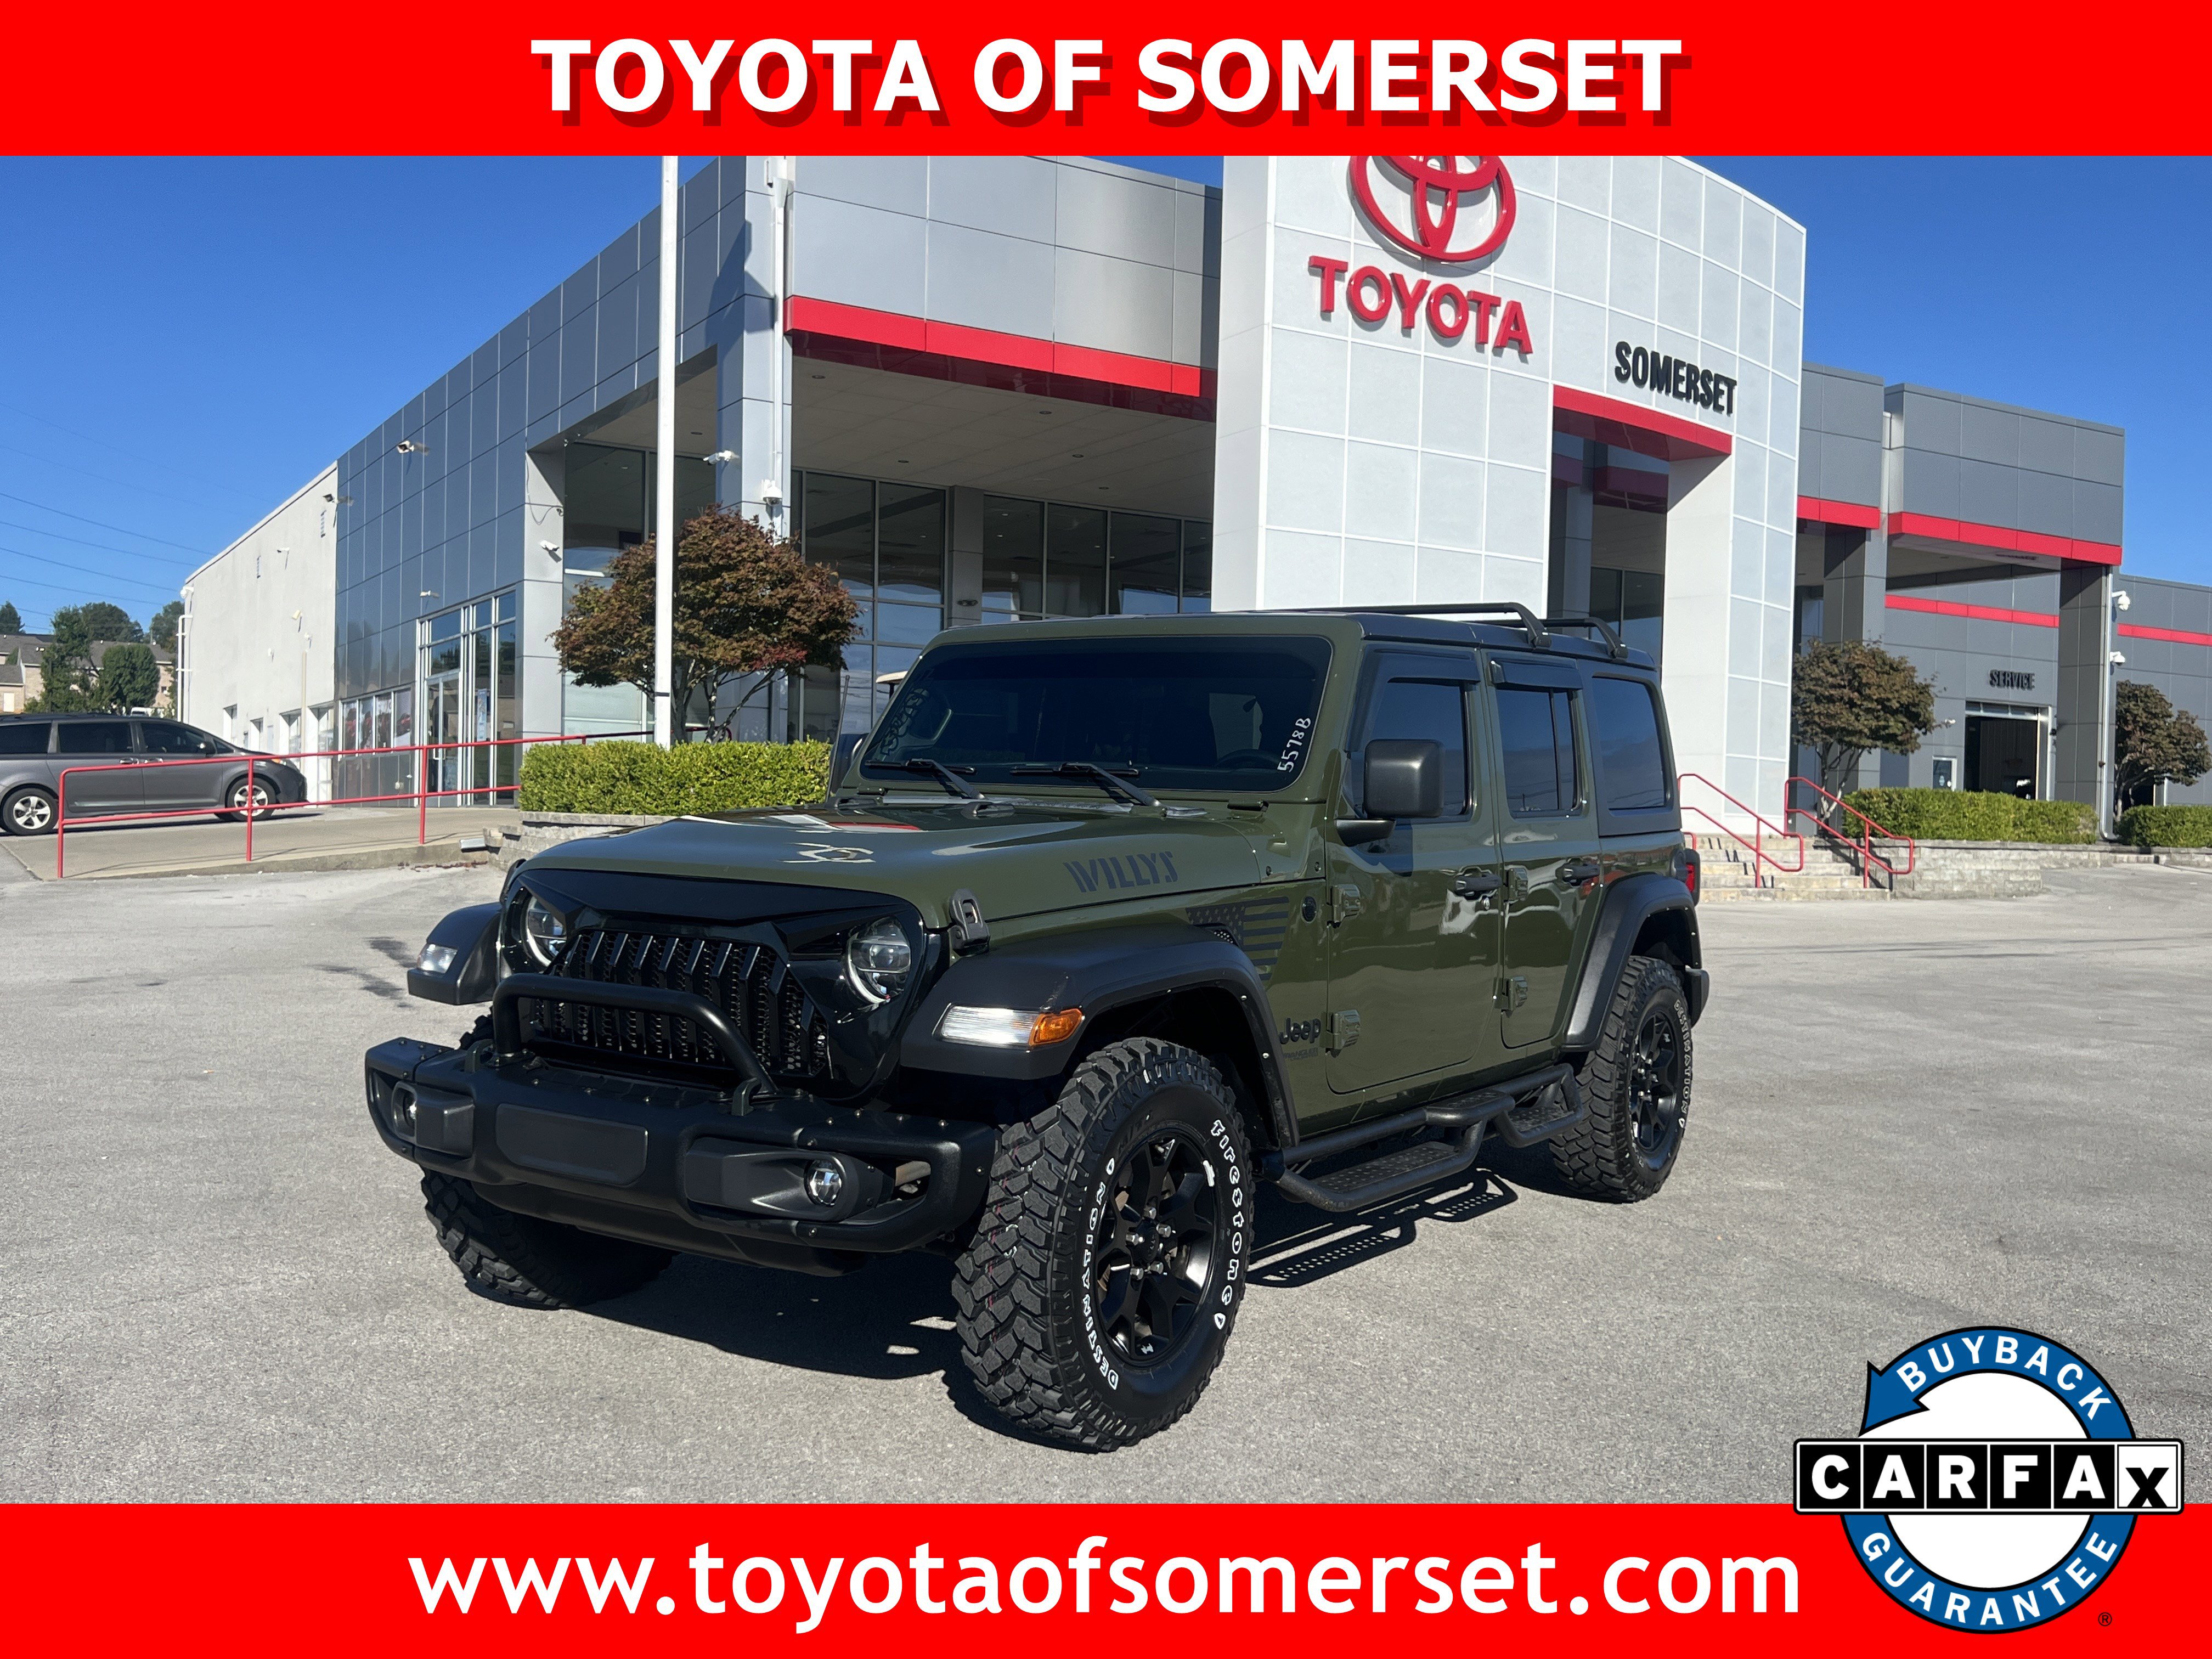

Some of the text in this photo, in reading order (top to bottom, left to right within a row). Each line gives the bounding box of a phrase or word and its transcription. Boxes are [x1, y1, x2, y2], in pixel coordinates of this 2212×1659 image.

[1309, 255, 1533, 354] TOYOTA
[1615, 341, 1737, 415] SOMERSET
[1989, 669, 2036, 691] SERVICE
[1277, 718, 1311, 773] 5578B
[1063, 851, 1178, 893] WILLYS
[1279, 1017, 1321, 1045] Jeep
[1674, 999, 1691, 1114] DESTINATION
[1082, 1182, 1119, 1390] DESTINATION
